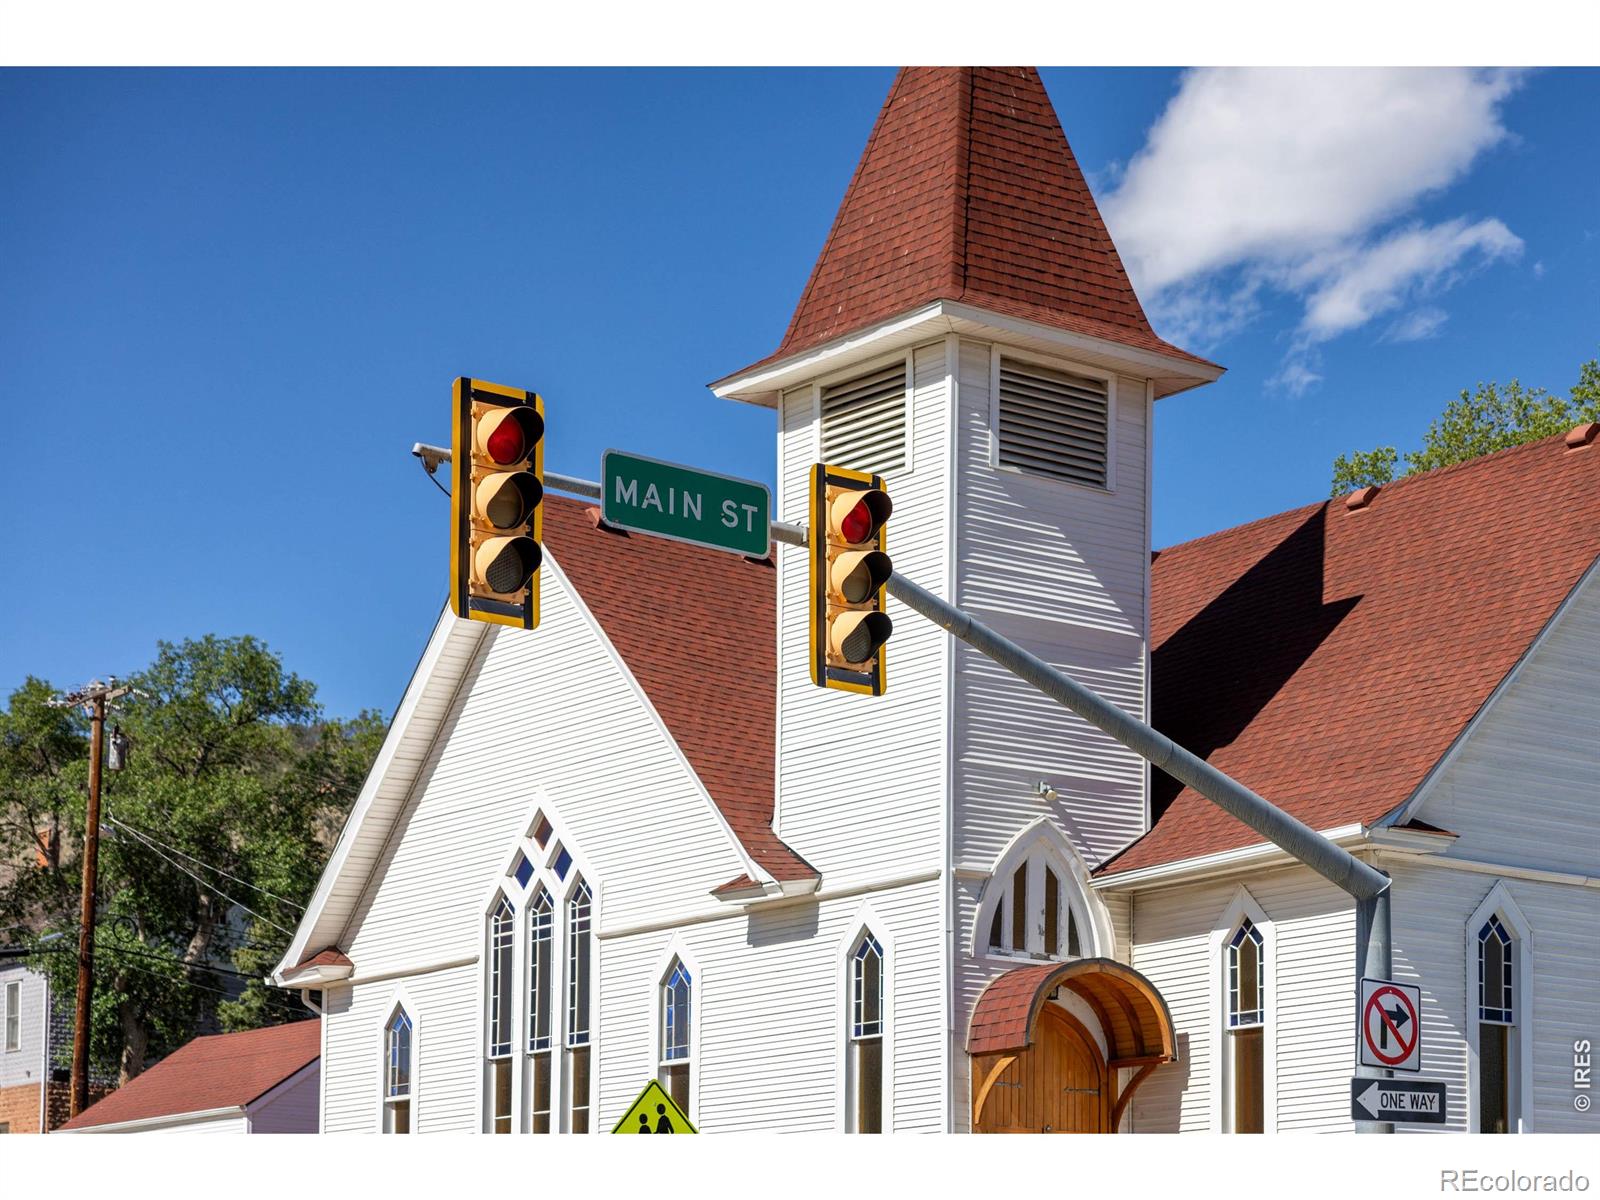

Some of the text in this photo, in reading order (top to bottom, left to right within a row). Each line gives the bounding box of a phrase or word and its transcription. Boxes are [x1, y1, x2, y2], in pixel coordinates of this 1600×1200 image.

[615, 475, 758, 532] MAIN ST
[1380, 1092, 1436, 1111] ONE WAY
